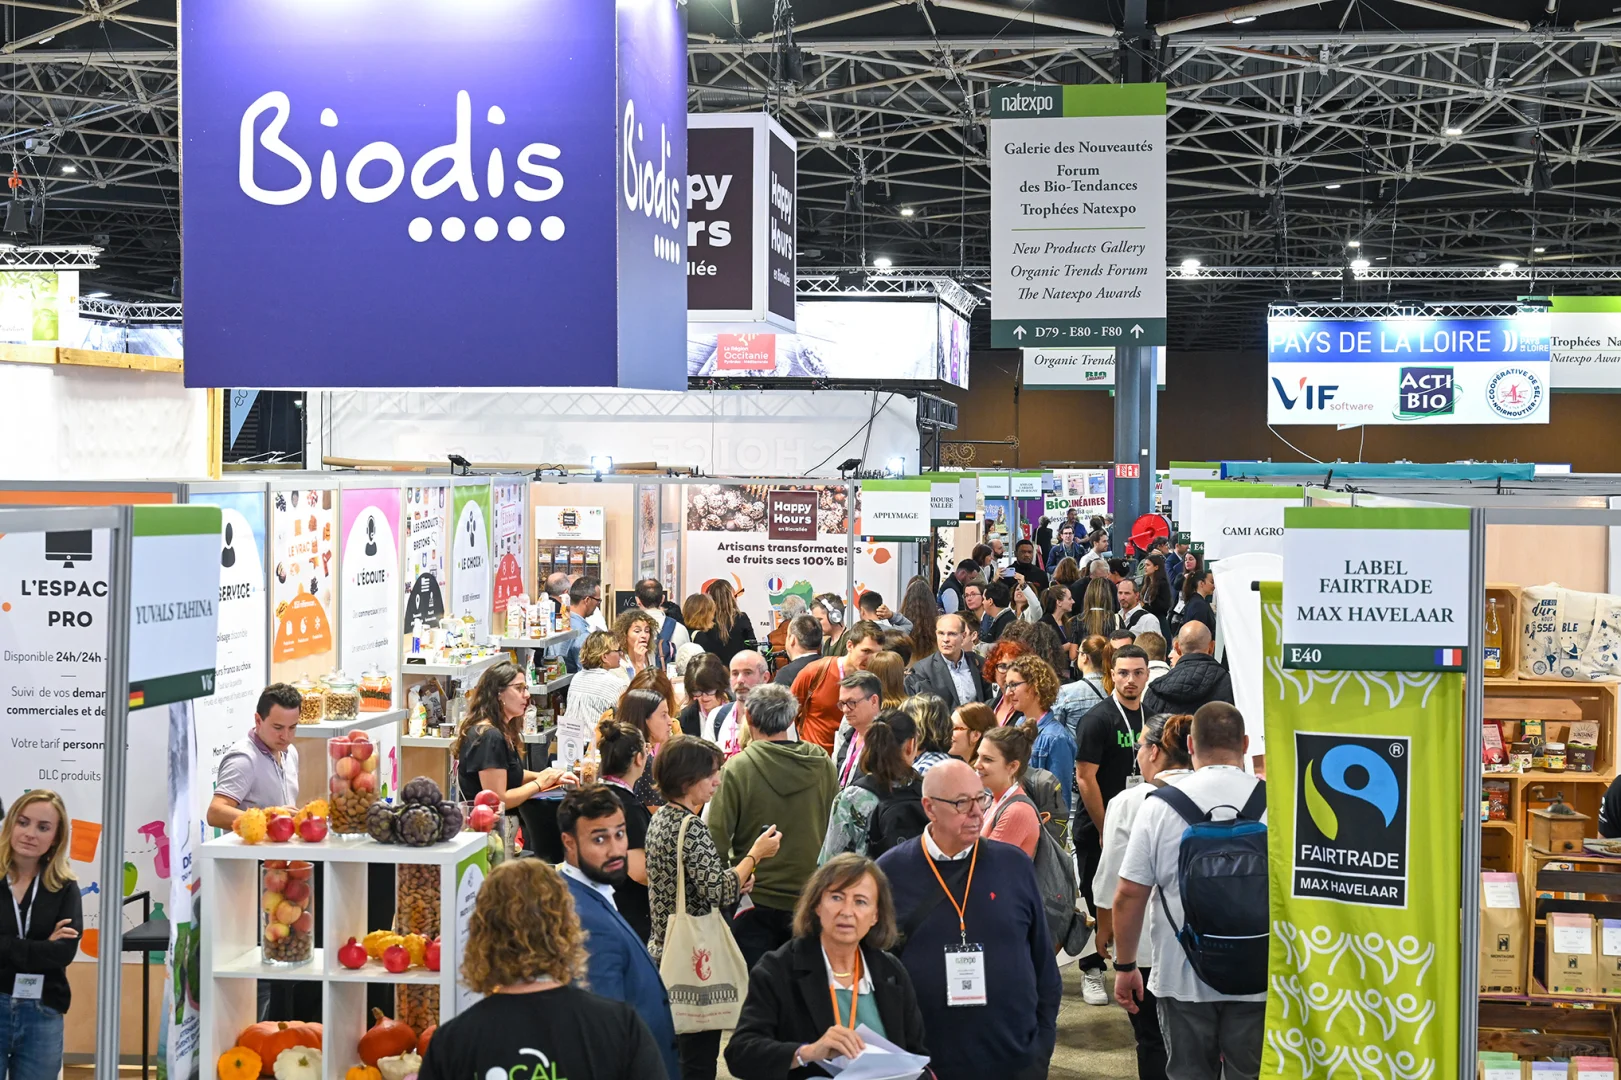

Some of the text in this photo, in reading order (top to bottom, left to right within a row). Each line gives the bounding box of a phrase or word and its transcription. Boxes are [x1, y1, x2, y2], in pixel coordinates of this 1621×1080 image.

[1001, 93, 1053, 114] natexpo
[239, 89, 564, 205] Biodis
[1005, 140, 1153, 155] Galerie des Nouveautés
[624, 99, 680, 230] Biodis
[1057, 165, 1100, 176] Forum
[687, 174, 733, 211] py
[1019, 179, 1138, 193] des Bio-Tendances
[771, 170, 793, 226] Happy
[1020, 203, 1136, 218] Trophées Natexpo
[687, 220, 732, 247] rs
[771, 216, 793, 261] Hours
[1013, 240, 1146, 256] New Products Gallery
[1010, 264, 1148, 280] Organic Trends Forum
[1018, 286, 1142, 302] The Natexpo Awards
[1035, 327, 1059, 337] D79
[1069, 327, 1091, 337] E80
[1101, 326, 1122, 337] F80
[1270, 330, 1491, 353] PAYS DE LA LOIRE
[1550, 336, 1621, 349] Trophées Na
[724, 352, 769, 360] Occitanie
[1034, 354, 1116, 368] Organic Trends
[1550, 352, 1621, 365] Natexpo Awar
[1400, 372, 1452, 390] ACTI
[1271, 376, 1339, 411] VIF
[1407, 392, 1447, 409] BIO
[1330, 402, 1374, 411] software
[1493, 402, 1536, 417] NOIRMOUTIER
[774, 501, 813, 515] Happy
[774, 513, 812, 525] Hours
[873, 512, 919, 520] APPLYMAGE
[1223, 526, 1284, 536] CAMI AGRO
[717, 542, 862, 554] Artisans transformateus
[1194, 543, 1203, 551] E4
[461, 556, 481, 570] LE CHOIX
[726, 555, 848, 566] de fruits secs 100% Bi
[1344, 559, 1408, 576] LABEL
[357, 568, 385, 586] L'ÉCOUTE
[21, 580, 108, 597] L'ESPAC
[1319, 578, 1433, 595] FAIRTRADE
[48, 611, 93, 628] PRO
[135, 599, 213, 625] YUVALS TAHINA
[1297, 606, 1455, 623] MAX HAVELAAR
[4, 651, 54, 664] Disponible
[56, 651, 102, 663] 24h/24h
[1291, 648, 1322, 663] E40
[201, 674, 214, 692] V6
[11, 686, 106, 698] Suivi de vos deman
[6, 706, 79, 716] commerciales
[81, 706, 92, 716] et
[11, 738, 105, 751] Votre tarif personn
[38, 769, 101, 782] DLC produits
[1301, 844, 1399, 870] FAIRTRADE
[1300, 877, 1399, 899] MAX HAVELAAR
